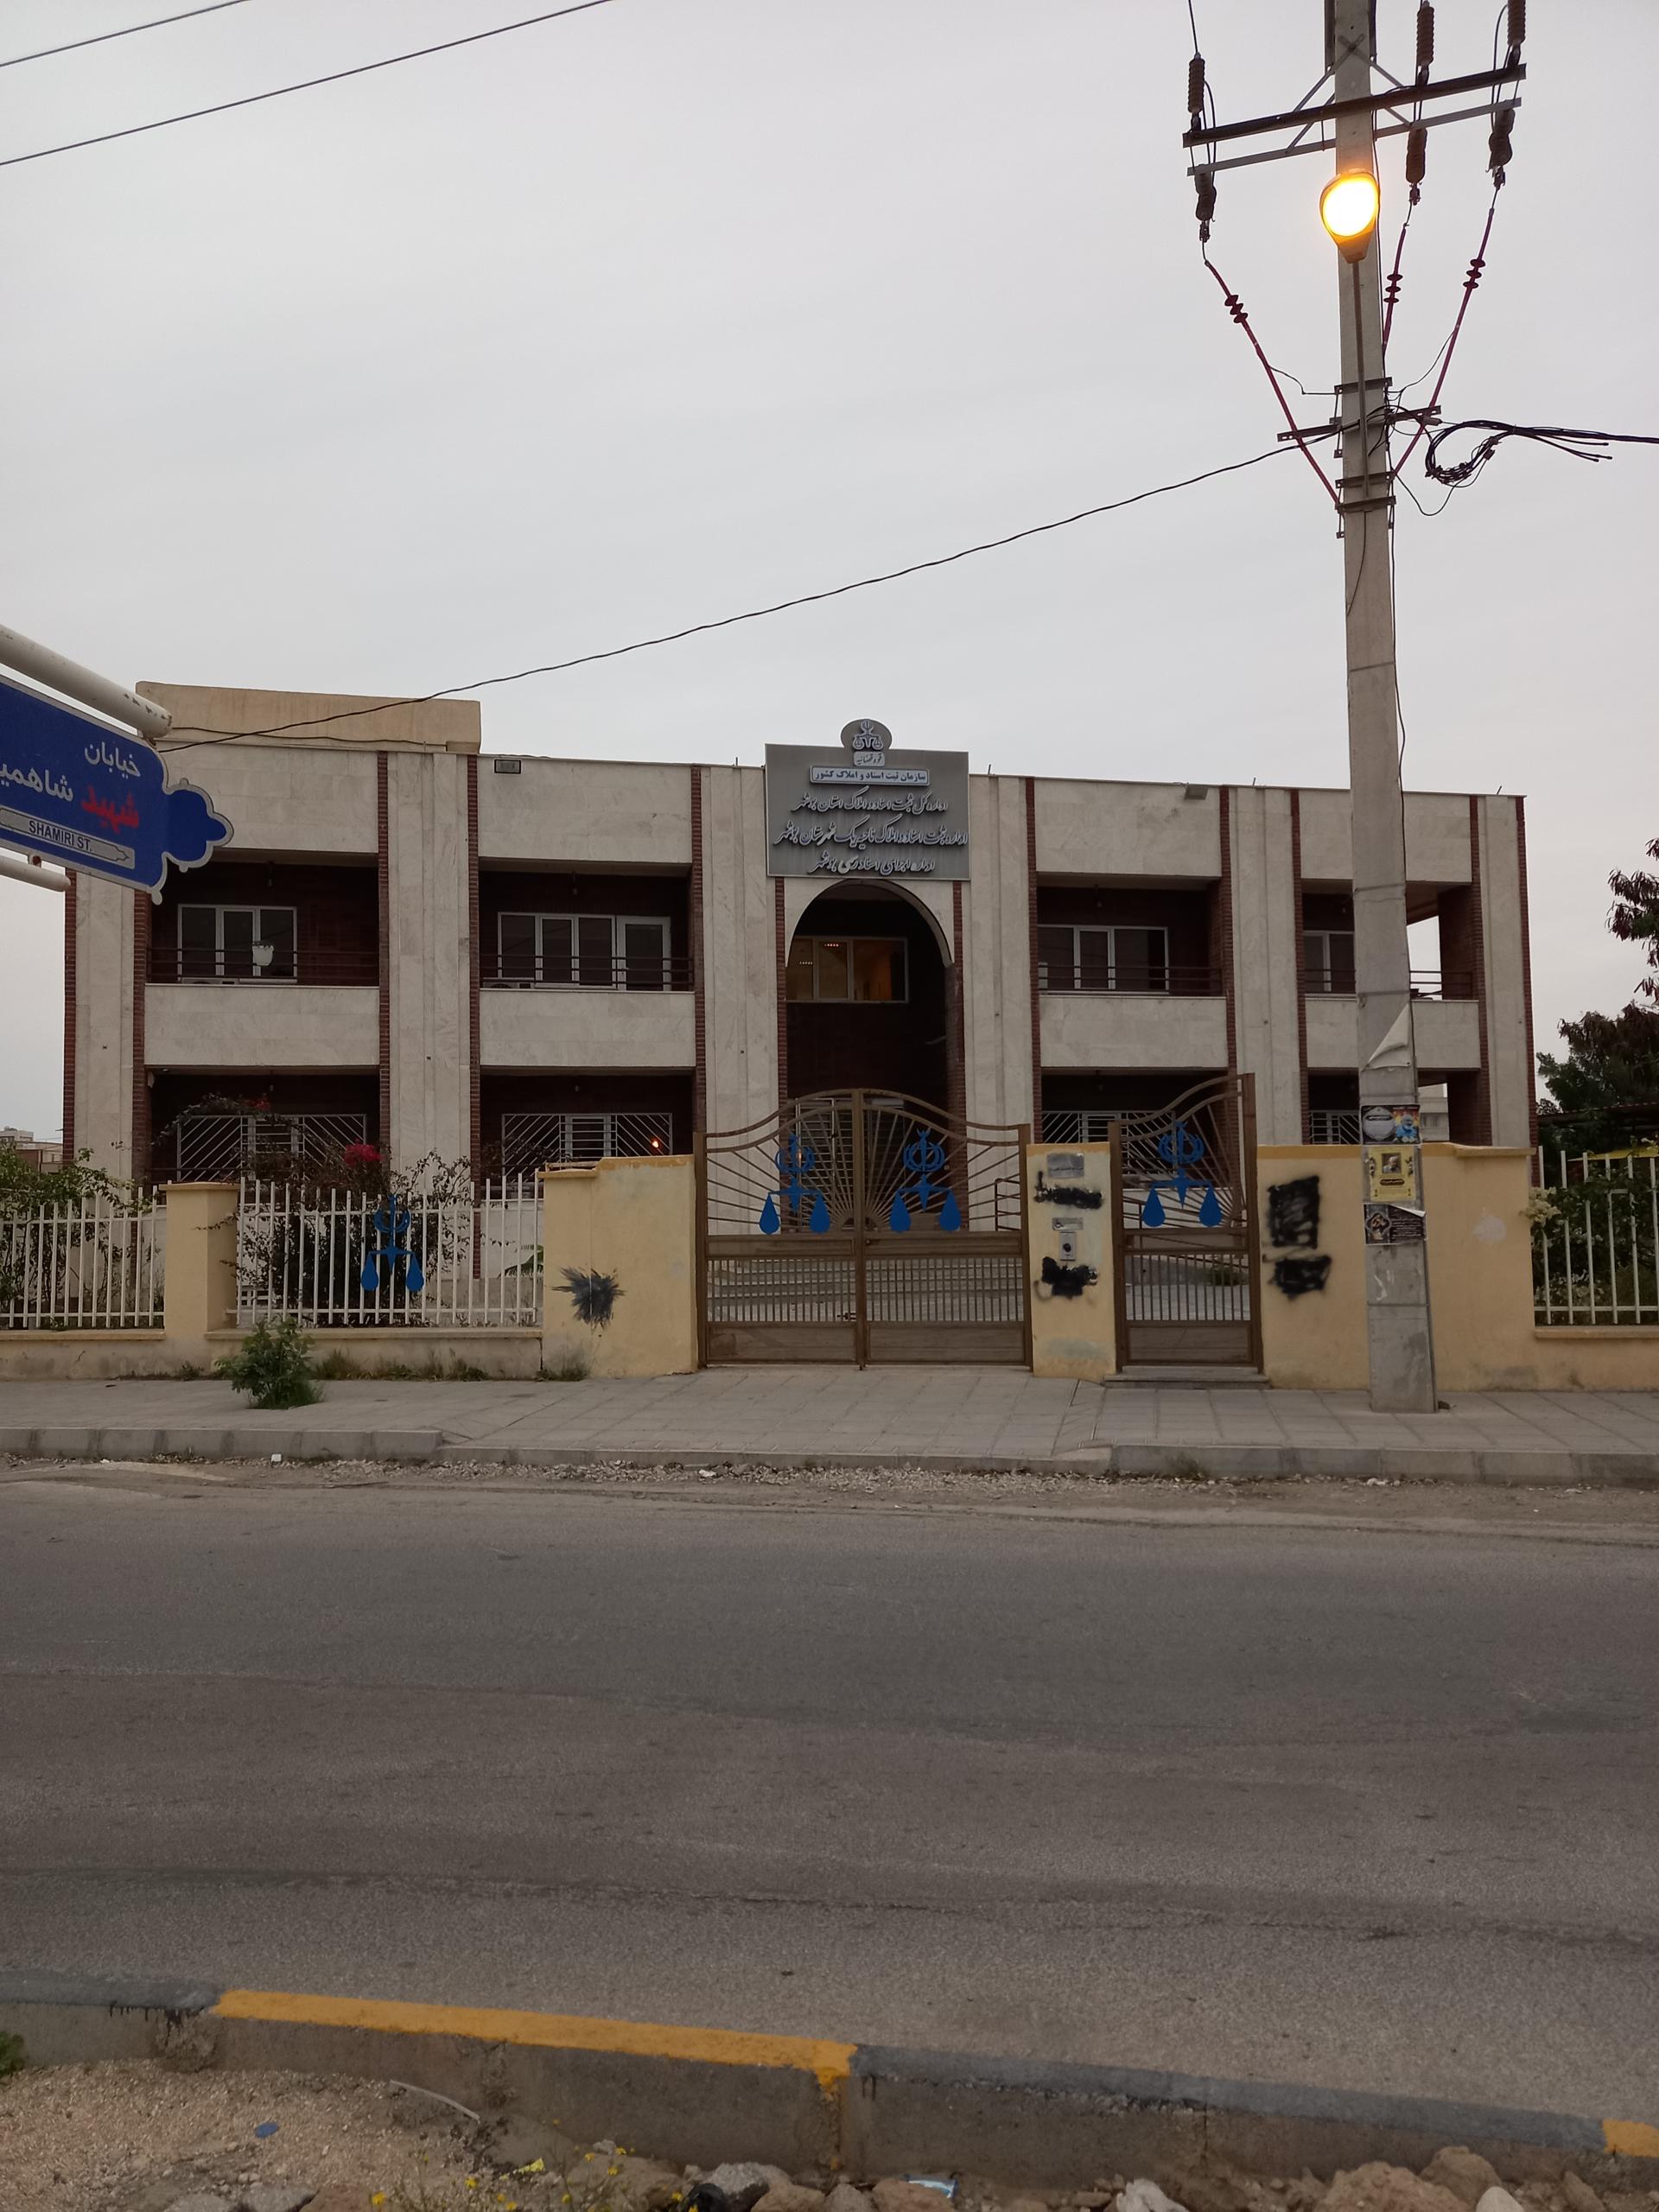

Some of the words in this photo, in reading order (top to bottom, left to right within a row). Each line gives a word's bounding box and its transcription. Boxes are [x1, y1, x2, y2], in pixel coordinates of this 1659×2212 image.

[85, 741, 141, 779] خیابان
[815, 770, 834, 780] کشور
[886, 772, 899, 781] ثبت
[900, 772, 926, 782] سازمان
[791, 792, 817, 813] بوشهر
[817, 795, 843, 812] استان
[843, 785, 869, 810] املاک
[872, 798, 892, 810] اسناد
[891, 793, 913, 813] ثبت
[912, 788, 933, 815] کل
[925, 799, 949, 812] اداره
[82, 785, 140, 835] شهید
[29, 820, 74, 846] SHAMIRI
[77, 836, 92, 852] ST.
[773, 819, 799, 845] بوشهر
[799, 822, 836, 846] شهرستان
[874, 813, 903, 843] املاک
[904, 830, 924, 844] اسناد
[923, 823, 947, 846] ثبت
[944, 830, 968, 846] اداره
[808, 849, 837, 874] بوشهر
[857, 857, 880, 871] اسناد
[910, 859, 935, 873] اداره
